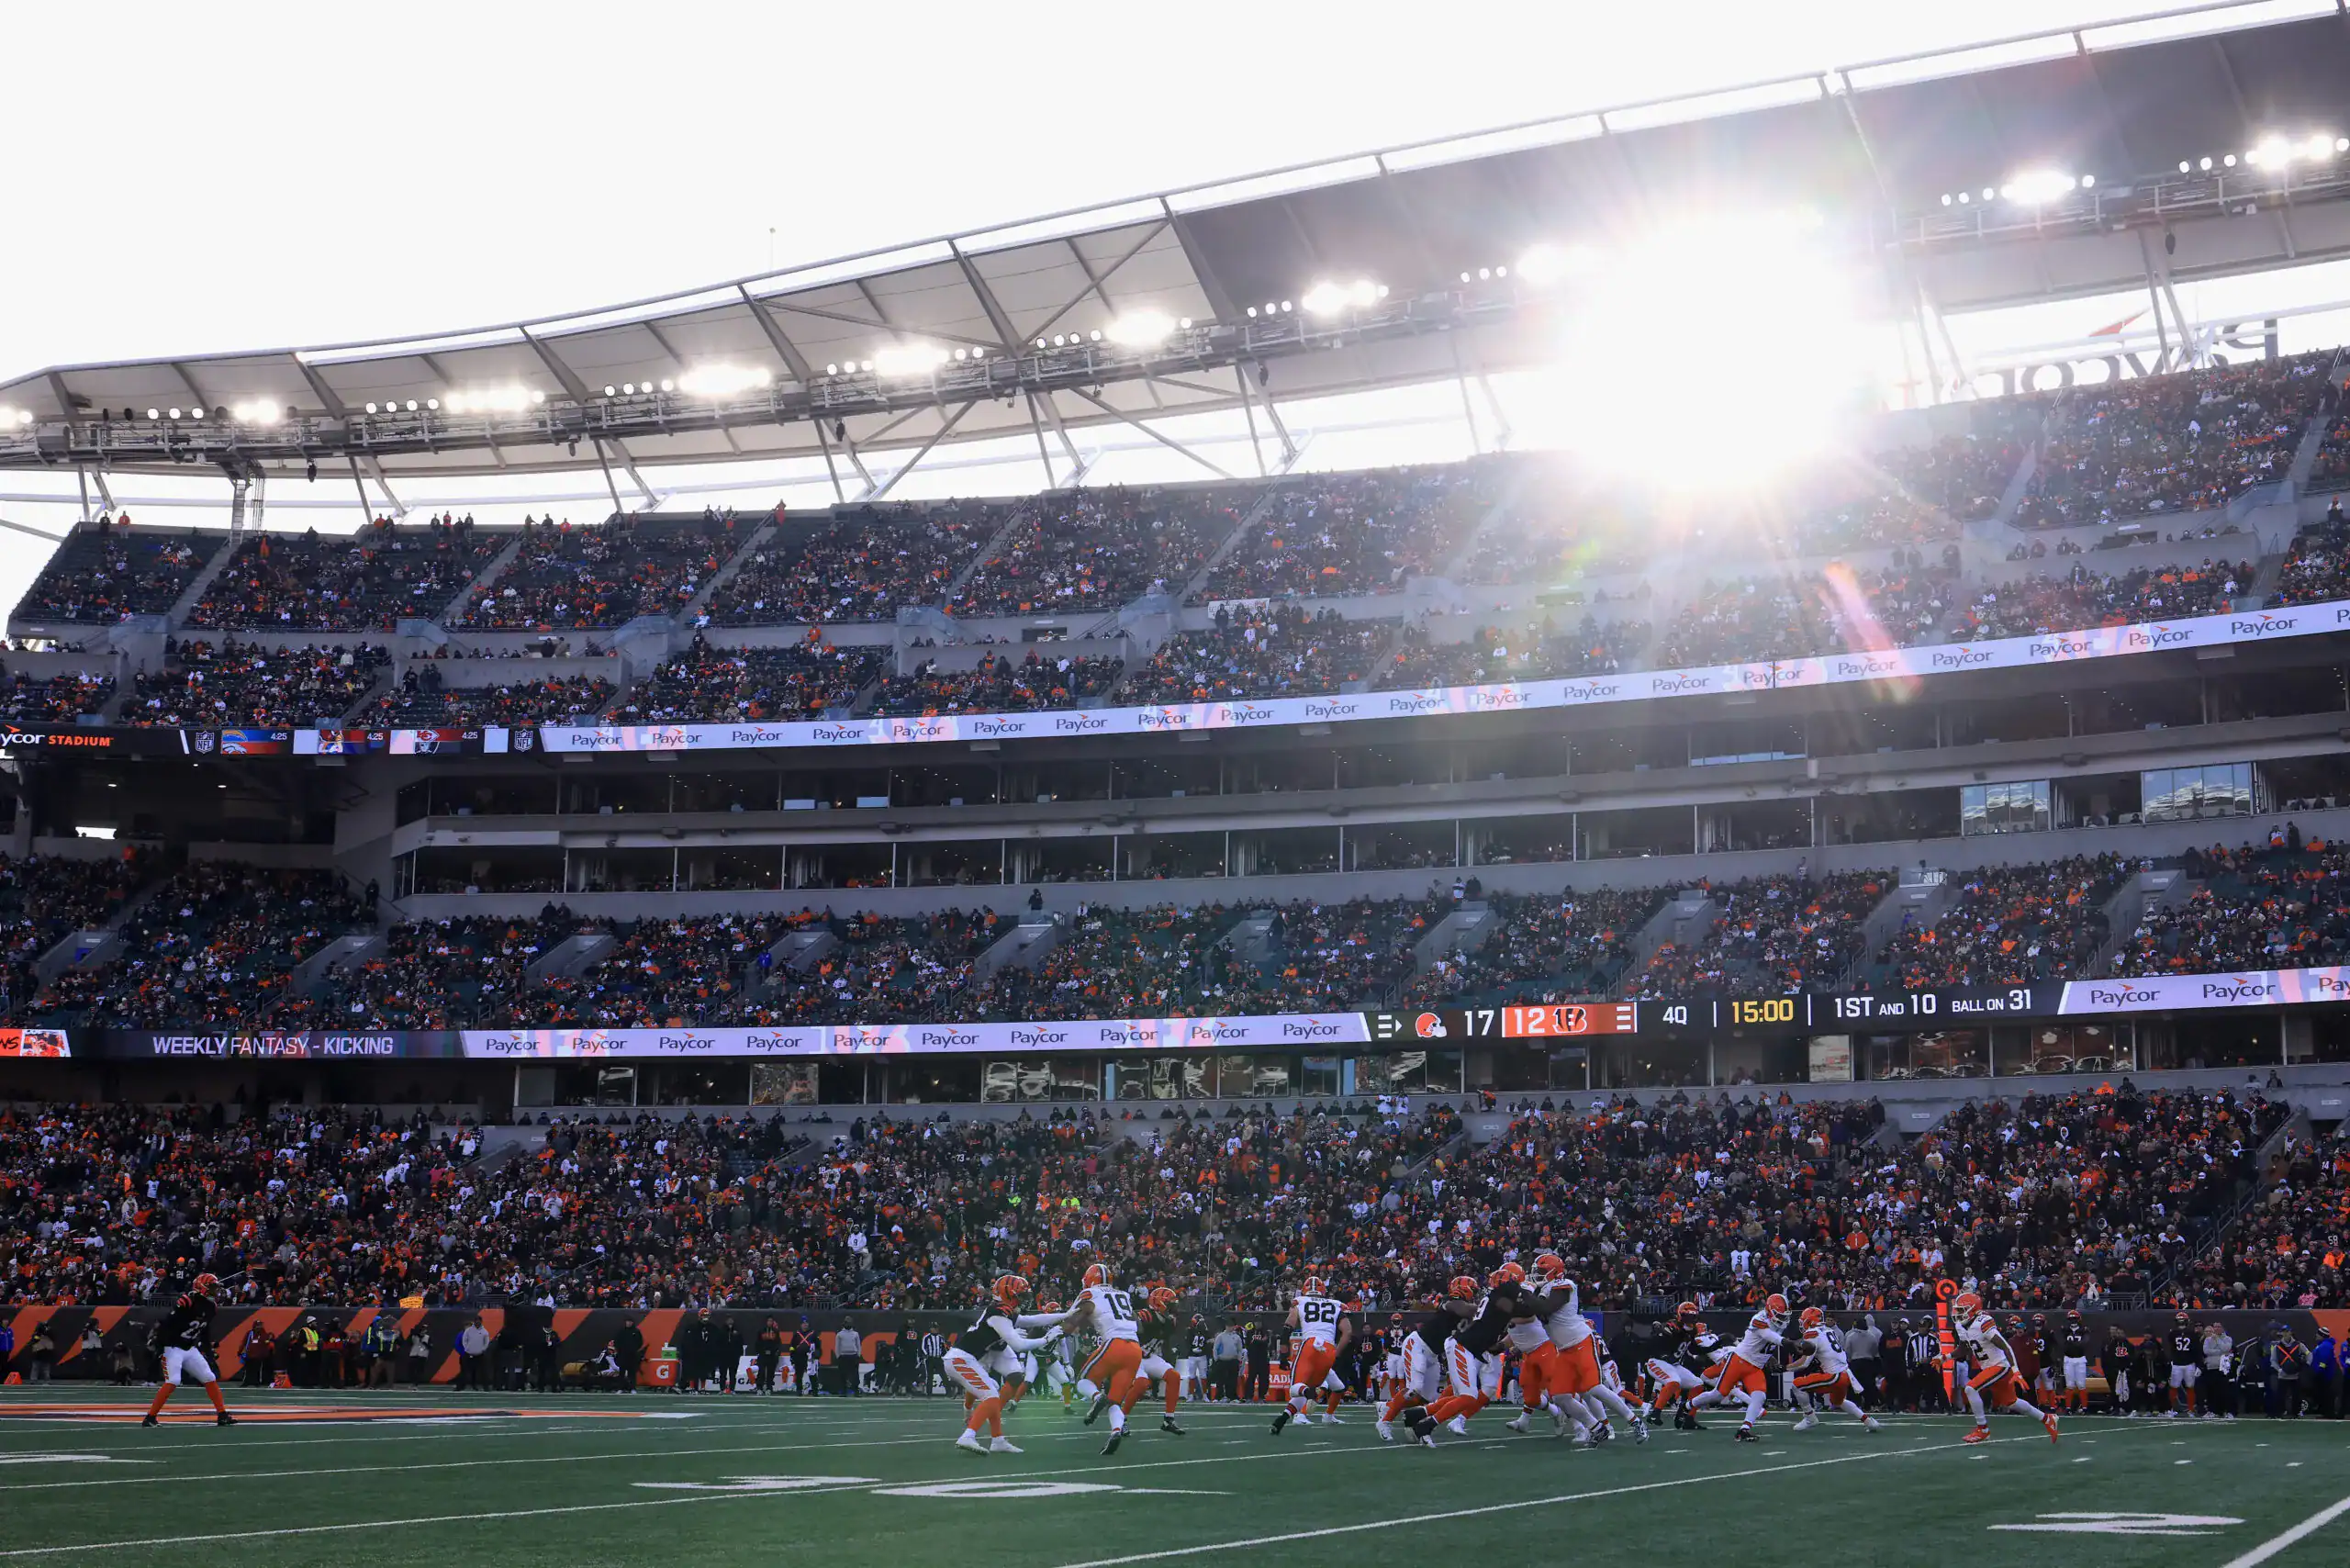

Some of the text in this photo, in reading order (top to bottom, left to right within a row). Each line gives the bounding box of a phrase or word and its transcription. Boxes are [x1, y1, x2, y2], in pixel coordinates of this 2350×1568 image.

[2232, 617, 2298, 635] Paycor
[2129, 629, 2194, 647] Paycor
[2030, 640, 2093, 658] Paycor
[1932, 649, 1994, 667] Paycor
[1838, 659, 1897, 677] Paycor
[1652, 677, 1708, 693] Paycor
[1744, 669, 1803, 688] Paycor
[1476, 691, 1531, 708] Paycor
[1564, 685, 1618, 700] Paycor
[1305, 703, 1359, 719] Paycor
[1390, 697, 1445, 713] Paycor
[1138, 712, 1191, 728] Paycor
[1222, 708, 1273, 724] Paycor
[893, 725, 943, 740] Paycor
[974, 721, 1025, 735] Paycor
[1056, 717, 1107, 733] Paycor
[49, 735, 110, 745] STADIUM
[571, 734, 621, 747] Paycor
[653, 732, 701, 746] Paycor
[732, 731, 782, 745] Paycor
[813, 729, 863, 743] Paycor
[2091, 990, 2160, 1007] Paycor
[2203, 983, 2276, 1002] Paycor
[1835, 994, 1936, 1017] 1ST AND 10
[1952, 990, 2031, 1013] BALL ON 31
[1662, 1006, 1687, 1025] 4Q
[1732, 1000, 1794, 1024] 15:00
[1465, 1010, 1494, 1036] 17
[1515, 1008, 1546, 1034] 12
[922, 1032, 979, 1047] Paycor
[1011, 1030, 1069, 1046] Paycor
[1101, 1028, 1158, 1045] Paycor
[1192, 1026, 1249, 1042] Paycor
[1283, 1024, 1341, 1039] Paycor
[152, 1037, 226, 1054] WEEKLY
[230, 1037, 309, 1054] FANTASY
[323, 1036, 393, 1054] KICKING
[486, 1038, 540, 1053] Paycor
[572, 1038, 628, 1053] Paycor
[659, 1037, 715, 1052] Paycor
[746, 1036, 802, 1051] Paycor
[834, 1034, 890, 1049] Paycor
[1104, 1294, 1136, 1321] 19
[1304, 1302, 1336, 1325] 82
[1192, 1335, 1204, 1347] 43
[2175, 1337, 2191, 1352] 52
